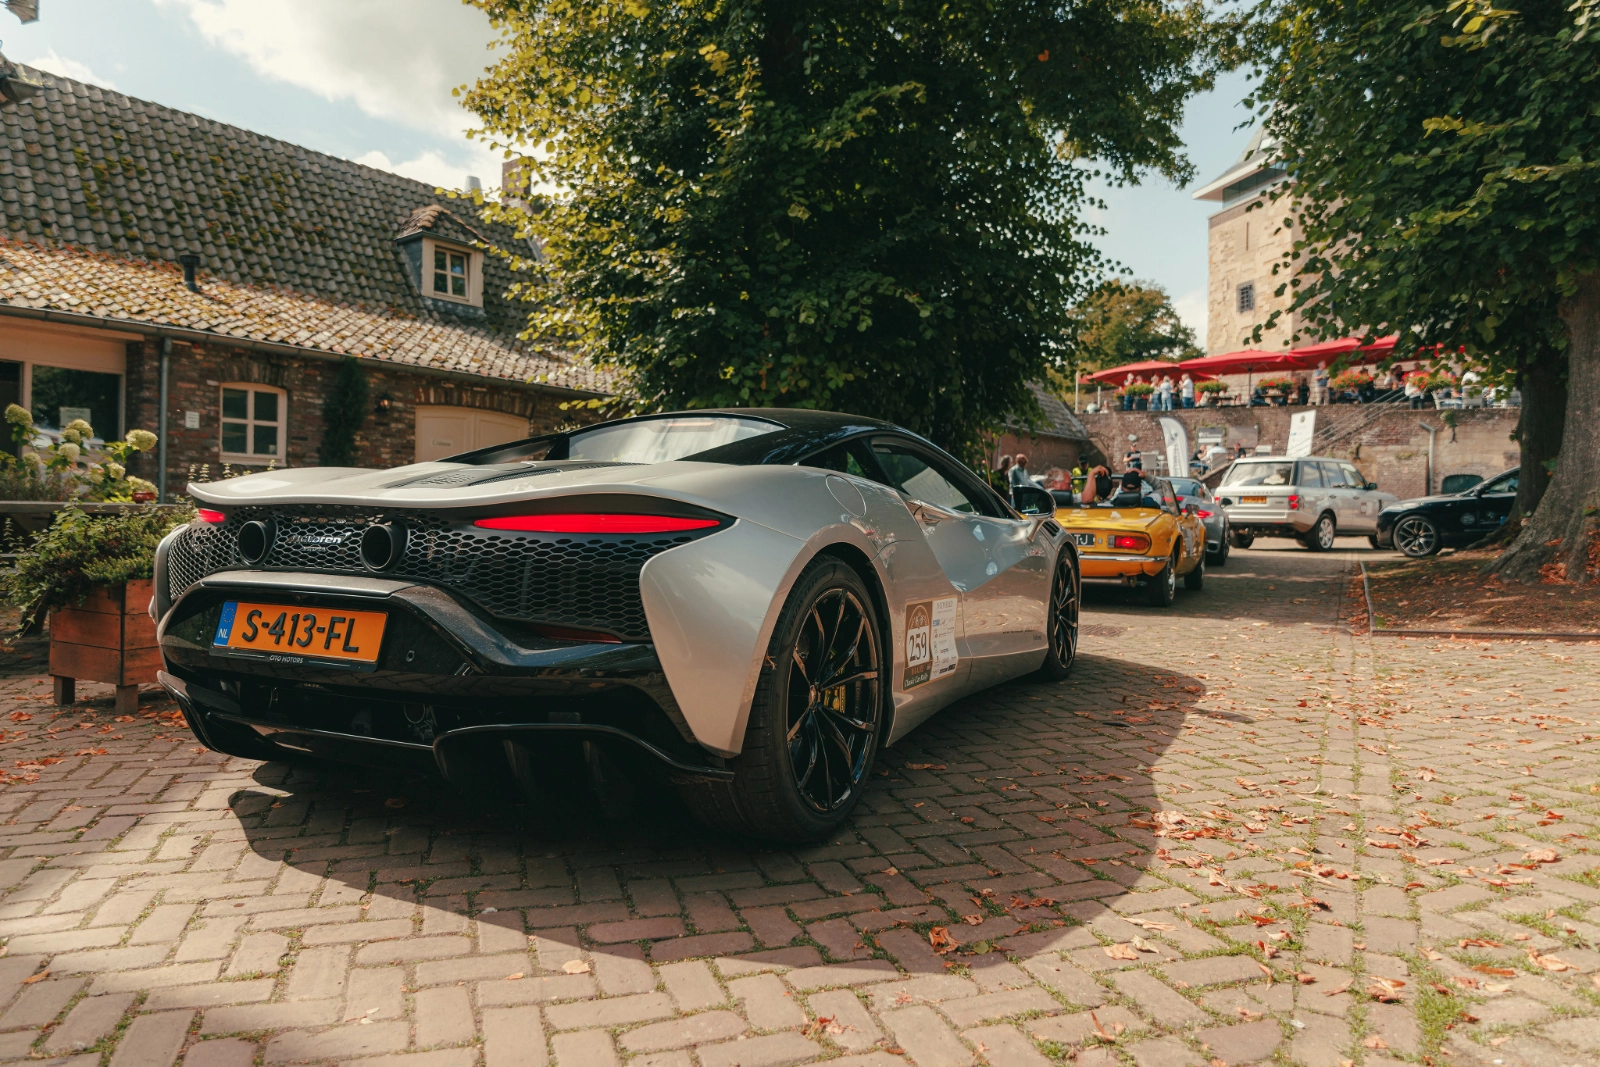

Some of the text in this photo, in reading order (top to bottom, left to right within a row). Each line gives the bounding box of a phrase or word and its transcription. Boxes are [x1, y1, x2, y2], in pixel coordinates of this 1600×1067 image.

[217, 628, 228, 639] NL
[241, 609, 359, 653] S-413-FL
[908, 632, 927, 662] 259
[281, 656, 304, 664] MOTORS
